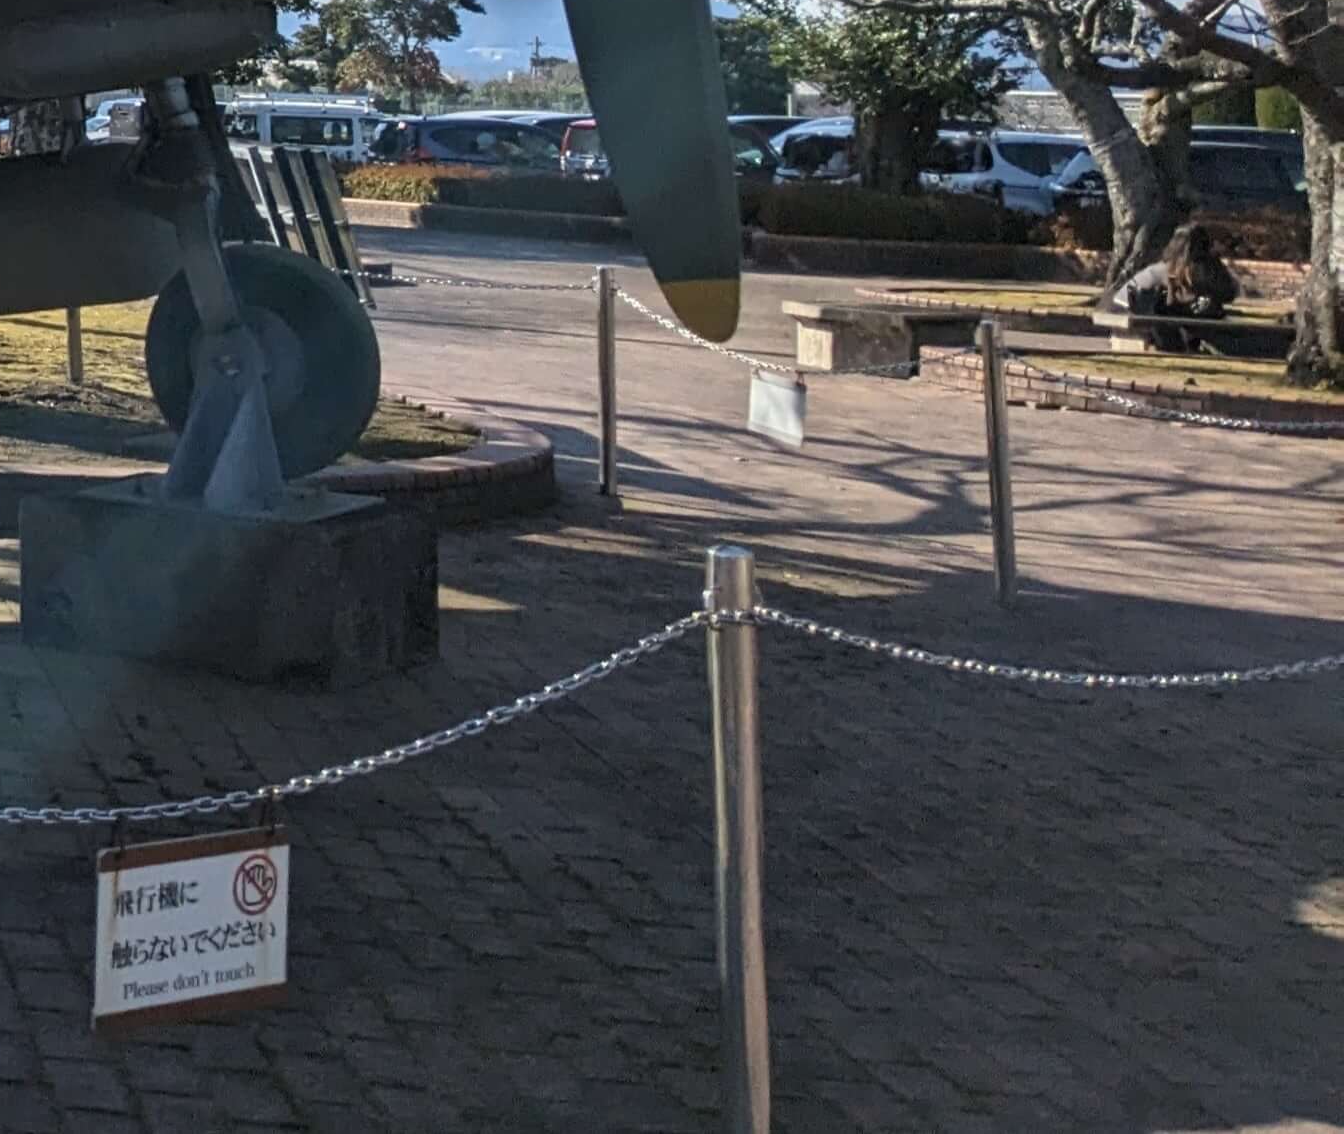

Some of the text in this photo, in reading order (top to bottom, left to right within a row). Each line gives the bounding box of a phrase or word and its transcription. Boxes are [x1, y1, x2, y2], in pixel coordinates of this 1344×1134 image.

[114, 881, 200, 917] 飛行機に
[111, 920, 276, 969] 触らないでください
[123, 962, 256, 1000] Please don't touch
